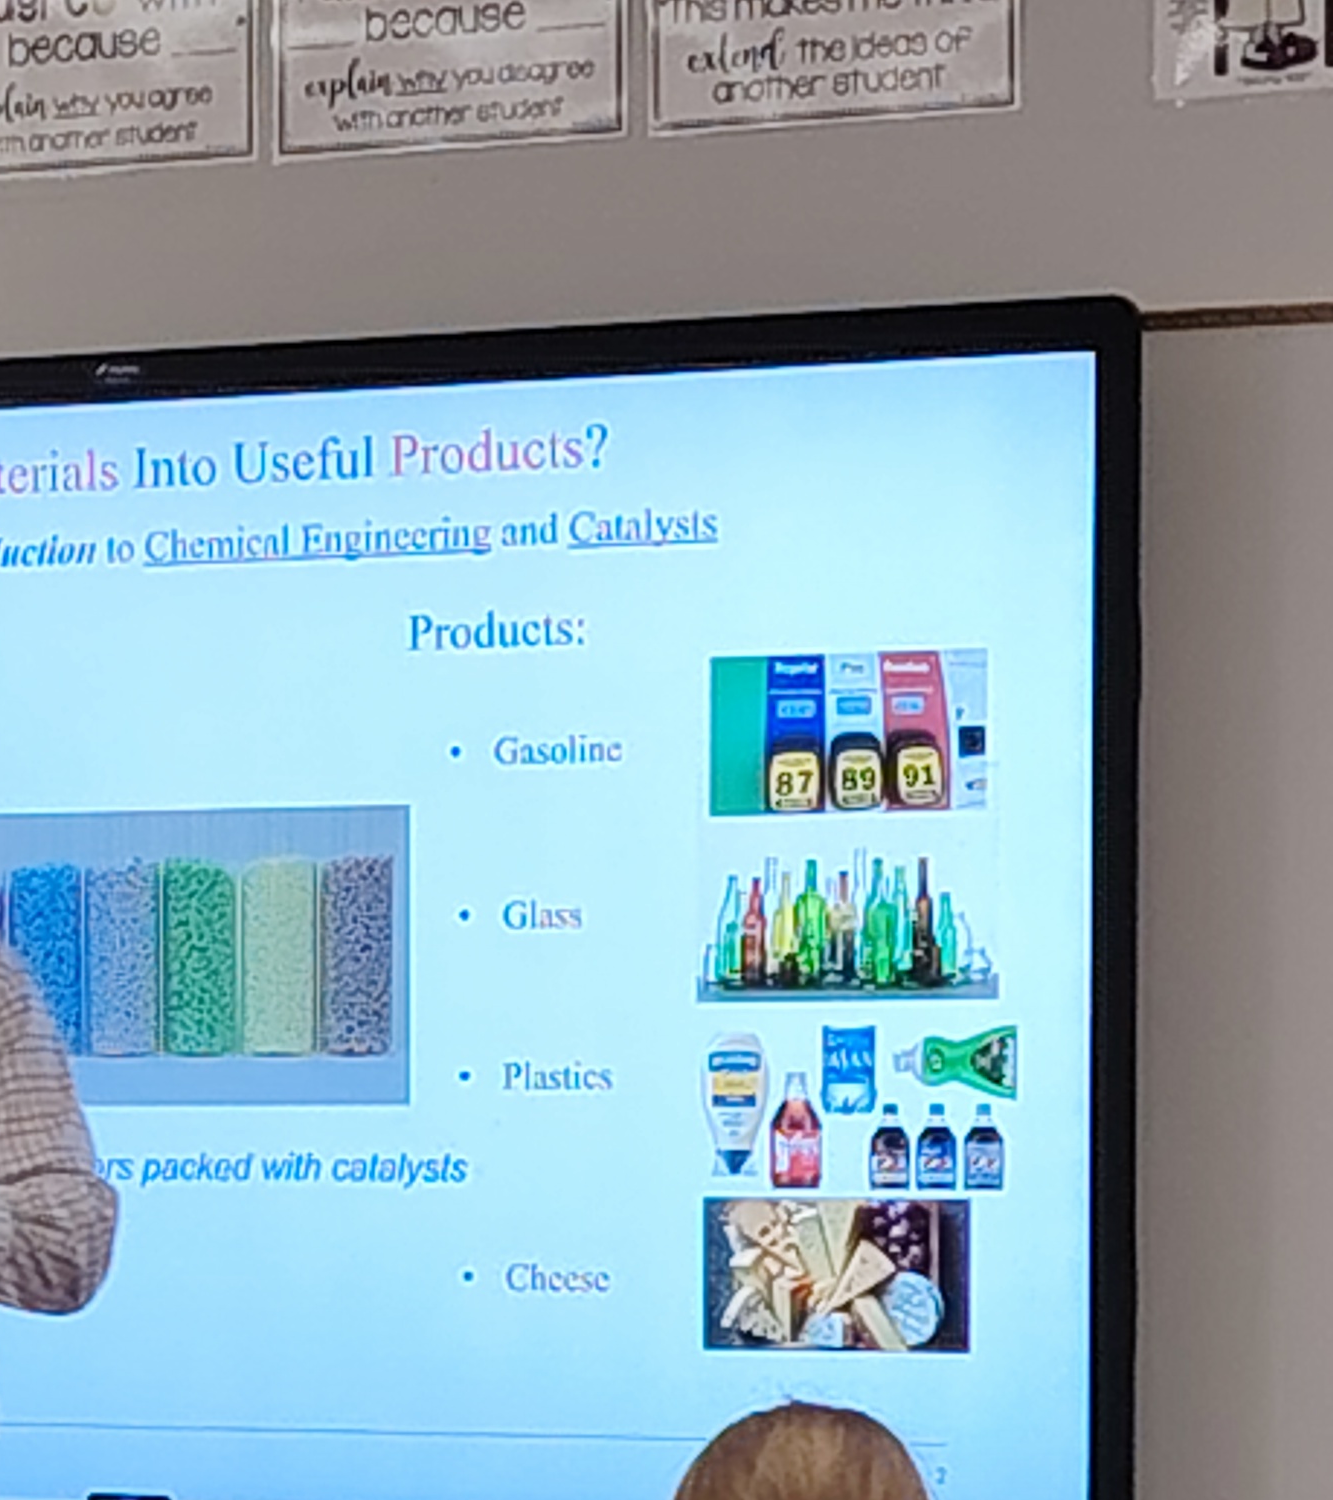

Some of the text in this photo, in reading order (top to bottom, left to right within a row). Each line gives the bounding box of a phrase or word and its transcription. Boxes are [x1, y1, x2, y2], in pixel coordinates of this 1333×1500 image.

[364, 1, 527, 43] because
[7, 26, 162, 69] because
[687, 26, 974, 74] extend the ideas of
[303, 56, 595, 109] explain why you disagree
[710, 63, 945, 105] another student
[51, 92, 102, 121] why
[102, 90, 146, 116] you
[146, 84, 214, 113] agree
[331, 95, 564, 133] with another student
[114, 119, 199, 146] student
[133, 444, 217, 491] Into
[233, 434, 374, 485] Useful
[390, 422, 610, 478] Products?
[105, 534, 135, 565] to
[142, 523, 291, 566] Chemical
[301, 515, 492, 561] Engineering
[500, 512, 558, 548] and
[567, 507, 719, 551] Catalysts
[407, 609, 587, 653] Products:
[493, 734, 623, 768] Gasoline
[774, 770, 814, 797] 87
[841, 766, 877, 792] 89
[902, 763, 937, 789] 91
[502, 899, 583, 931] Glass
[502, 1060, 614, 1094] Plastics
[139, 1151, 255, 1188] packed
[261, 1150, 323, 1183] with
[331, 1150, 469, 1191] catalysts
[504, 1261, 612, 1295] Cheese
